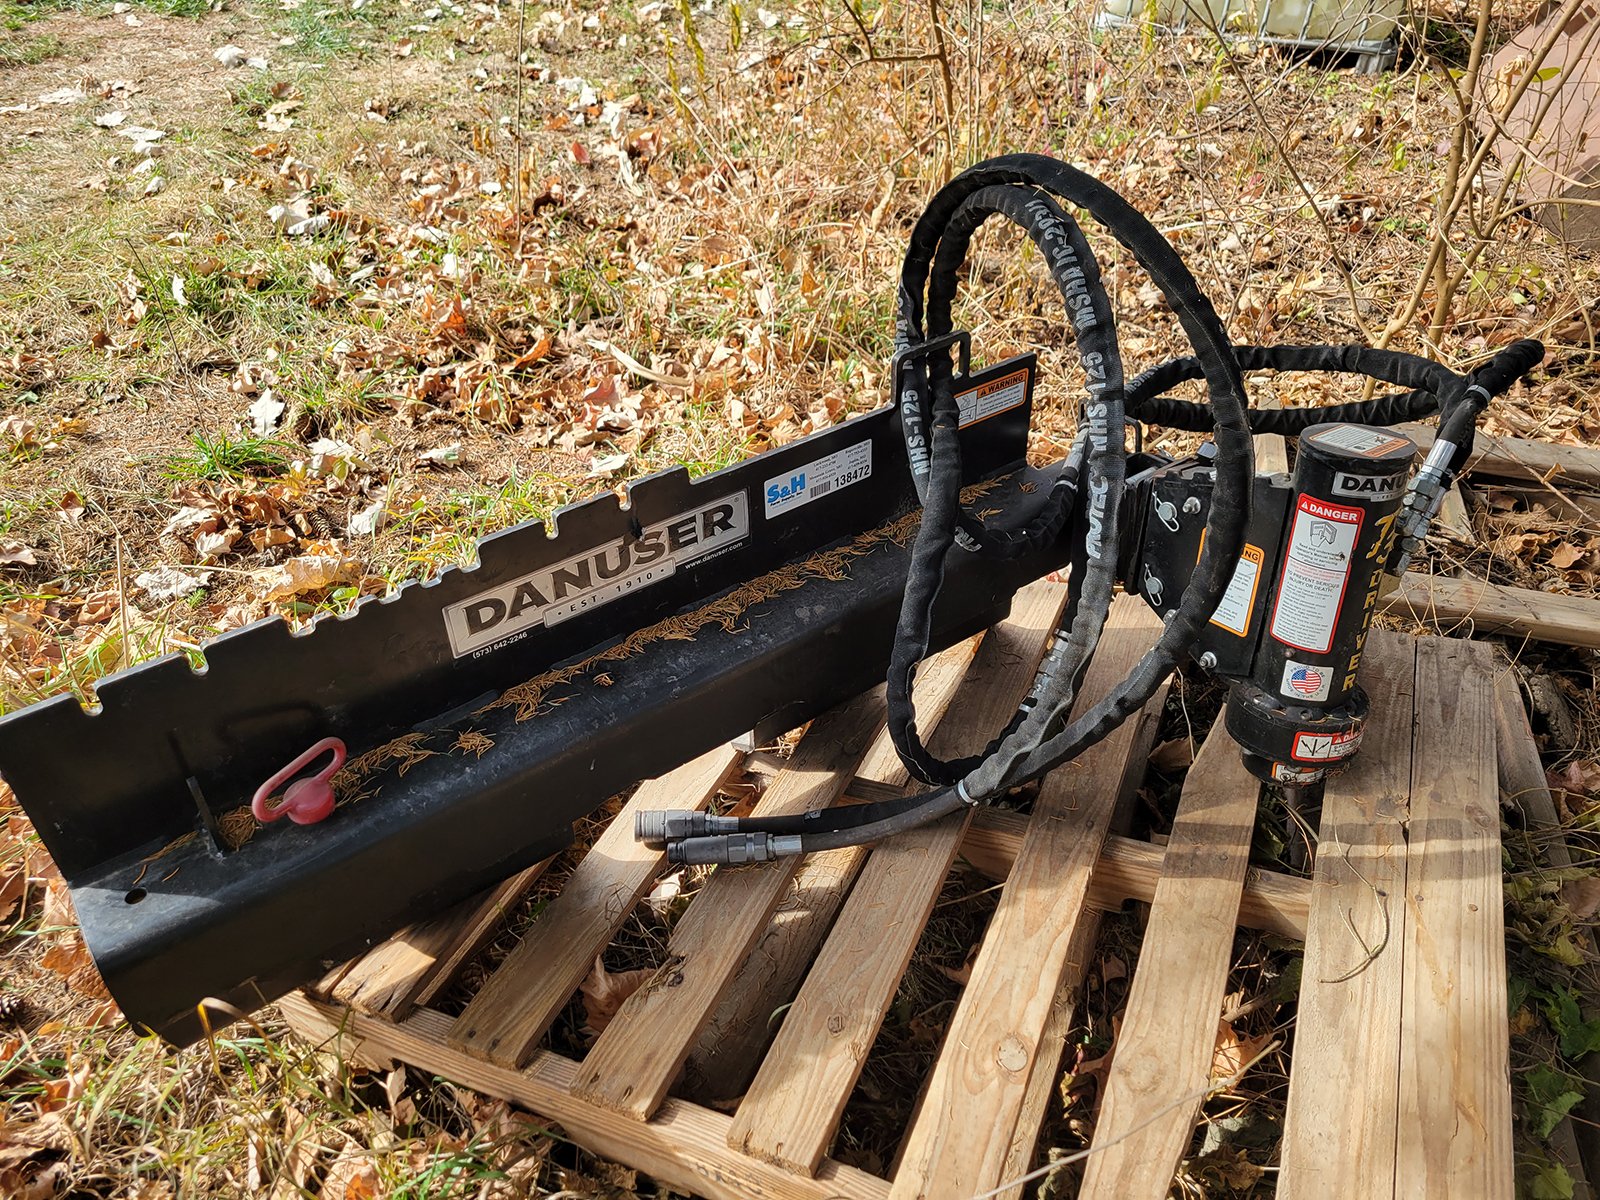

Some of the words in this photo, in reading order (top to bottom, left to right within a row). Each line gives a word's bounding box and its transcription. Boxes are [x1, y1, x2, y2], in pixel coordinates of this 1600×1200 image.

[1060, 265, 1097, 331] MSHA
[988, 373, 1024, 392] WARNING
[1082, 350, 1108, 451] NHS-125
[901, 388, 931, 476] NHS-125
[767, 472, 806, 504] S&H
[834, 464, 870, 488] 138472
[1309, 503, 1358, 521] DANGER
[463, 504, 738, 636] DANUSER
[684, 541, 744, 570] www.danuser.com
[570, 595, 604, 613] EST.
[615, 571, 654, 593] 1910
[472, 645, 492, 660] (573)
[493, 631, 528, 651] 642-2246
